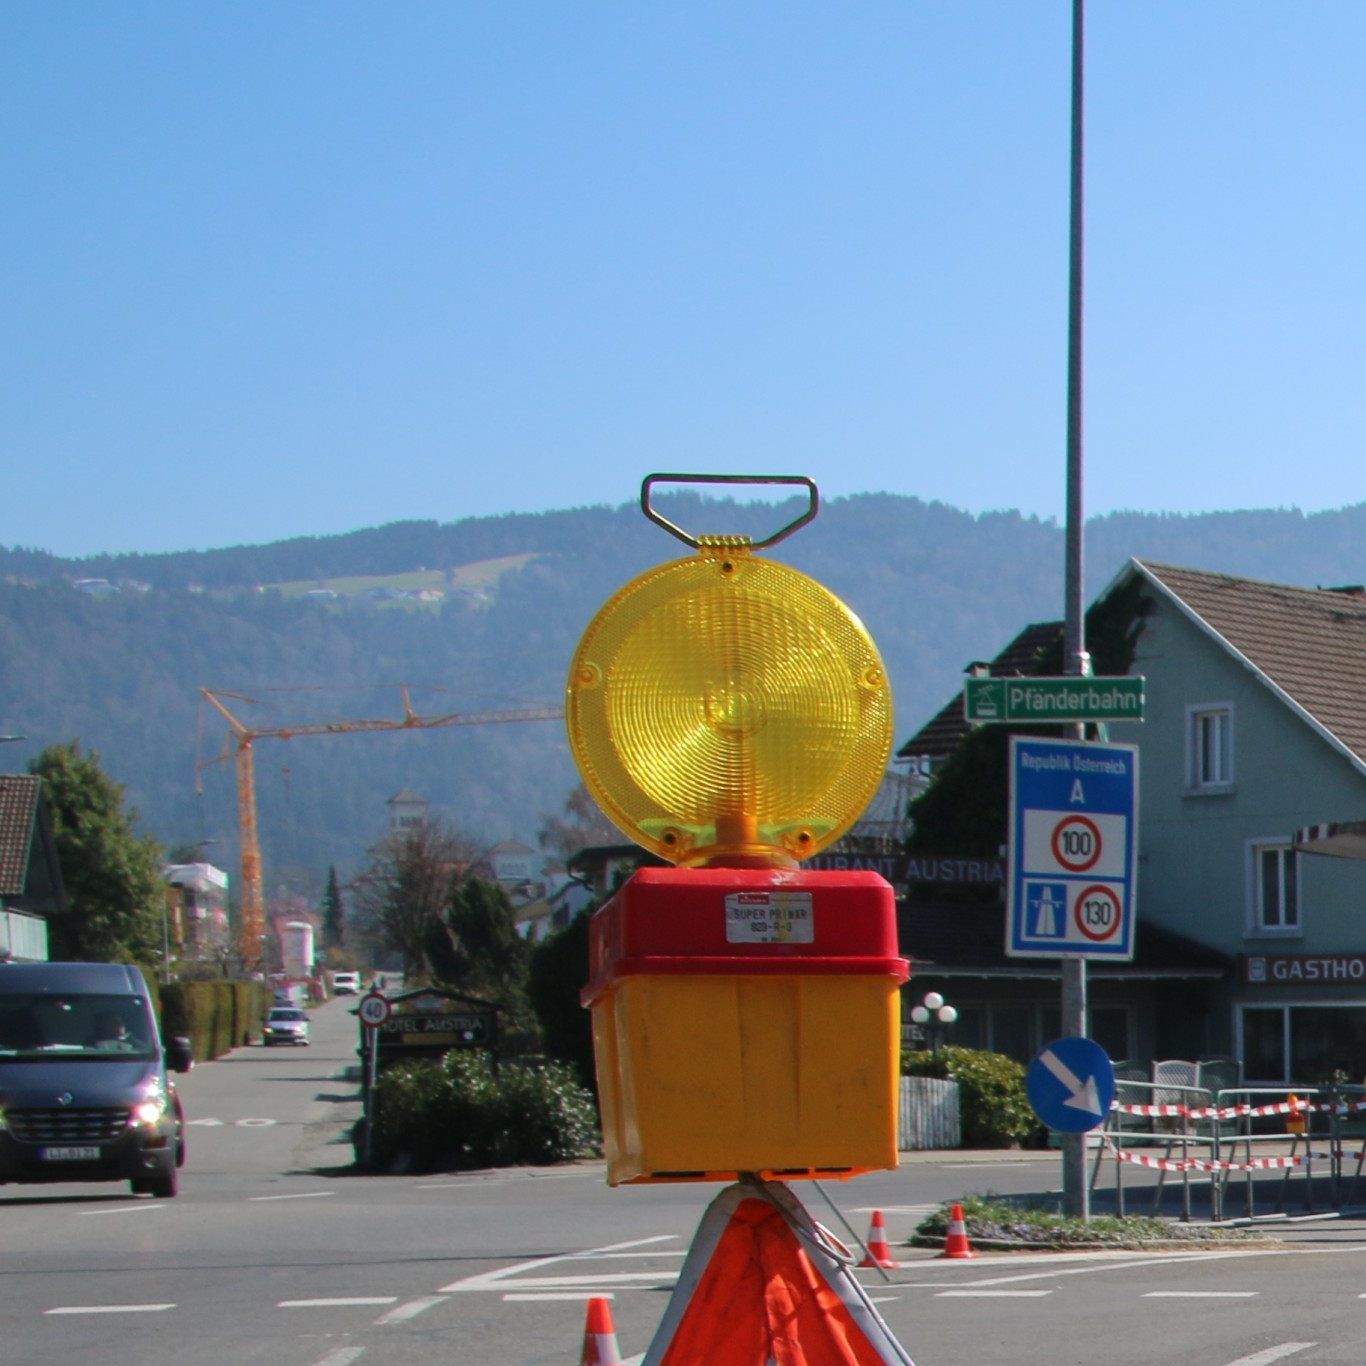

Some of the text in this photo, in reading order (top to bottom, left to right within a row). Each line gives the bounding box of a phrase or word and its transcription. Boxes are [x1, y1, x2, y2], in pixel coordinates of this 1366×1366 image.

[1010, 687, 1137, 710] Pfänderbahn
[1021, 752, 1126, 775] Republik Österreich
[1069, 778, 1086, 804] A
[1062, 831, 1091, 856] 100
[905, 858, 1004, 881] AUSTRIA
[733, 908, 766, 920] SUPER
[1084, 901, 1111, 926] 130
[365, 1002, 383, 1019] 40
